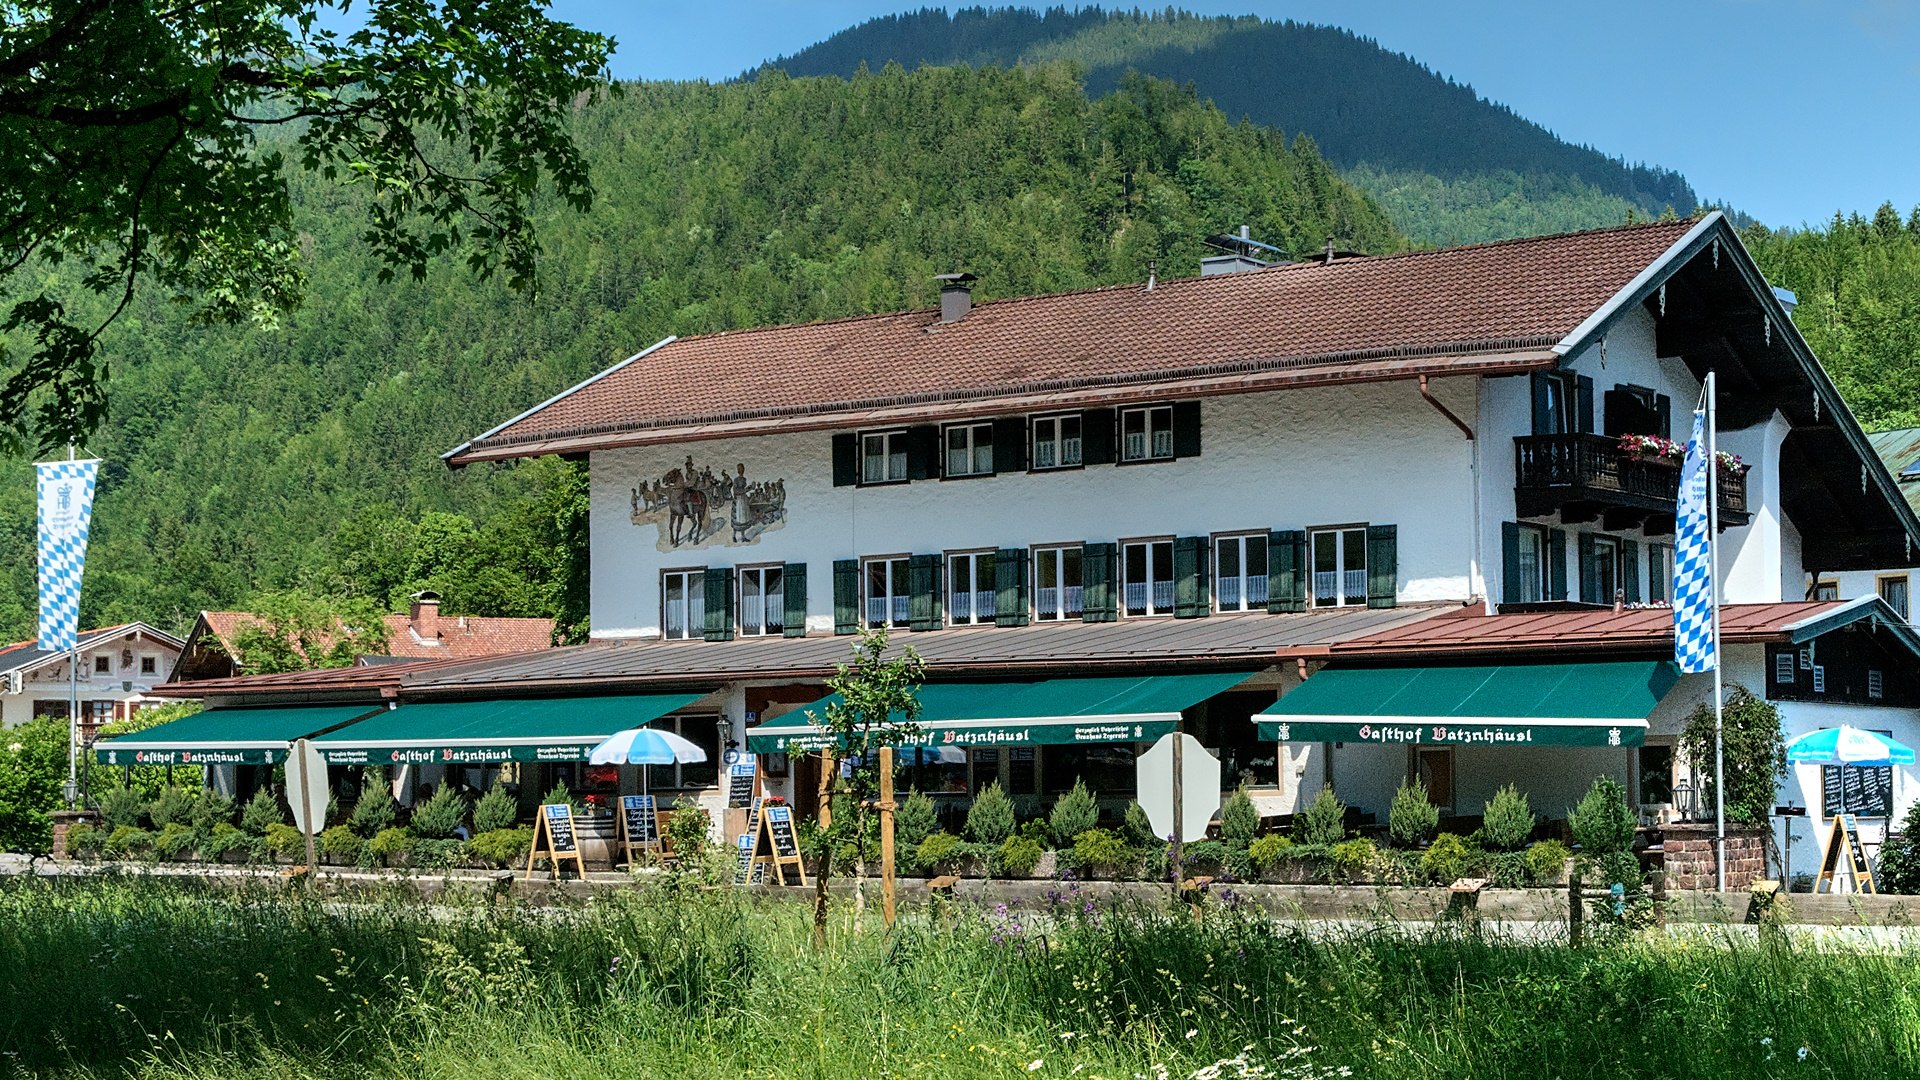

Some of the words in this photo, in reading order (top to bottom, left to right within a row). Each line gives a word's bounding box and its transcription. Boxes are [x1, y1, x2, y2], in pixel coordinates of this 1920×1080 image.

[943, 729, 1029, 744] Batznhäusl
[1432, 726, 1532, 743] Batznhäusl
[442, 748, 512, 762] Batznhäusl
